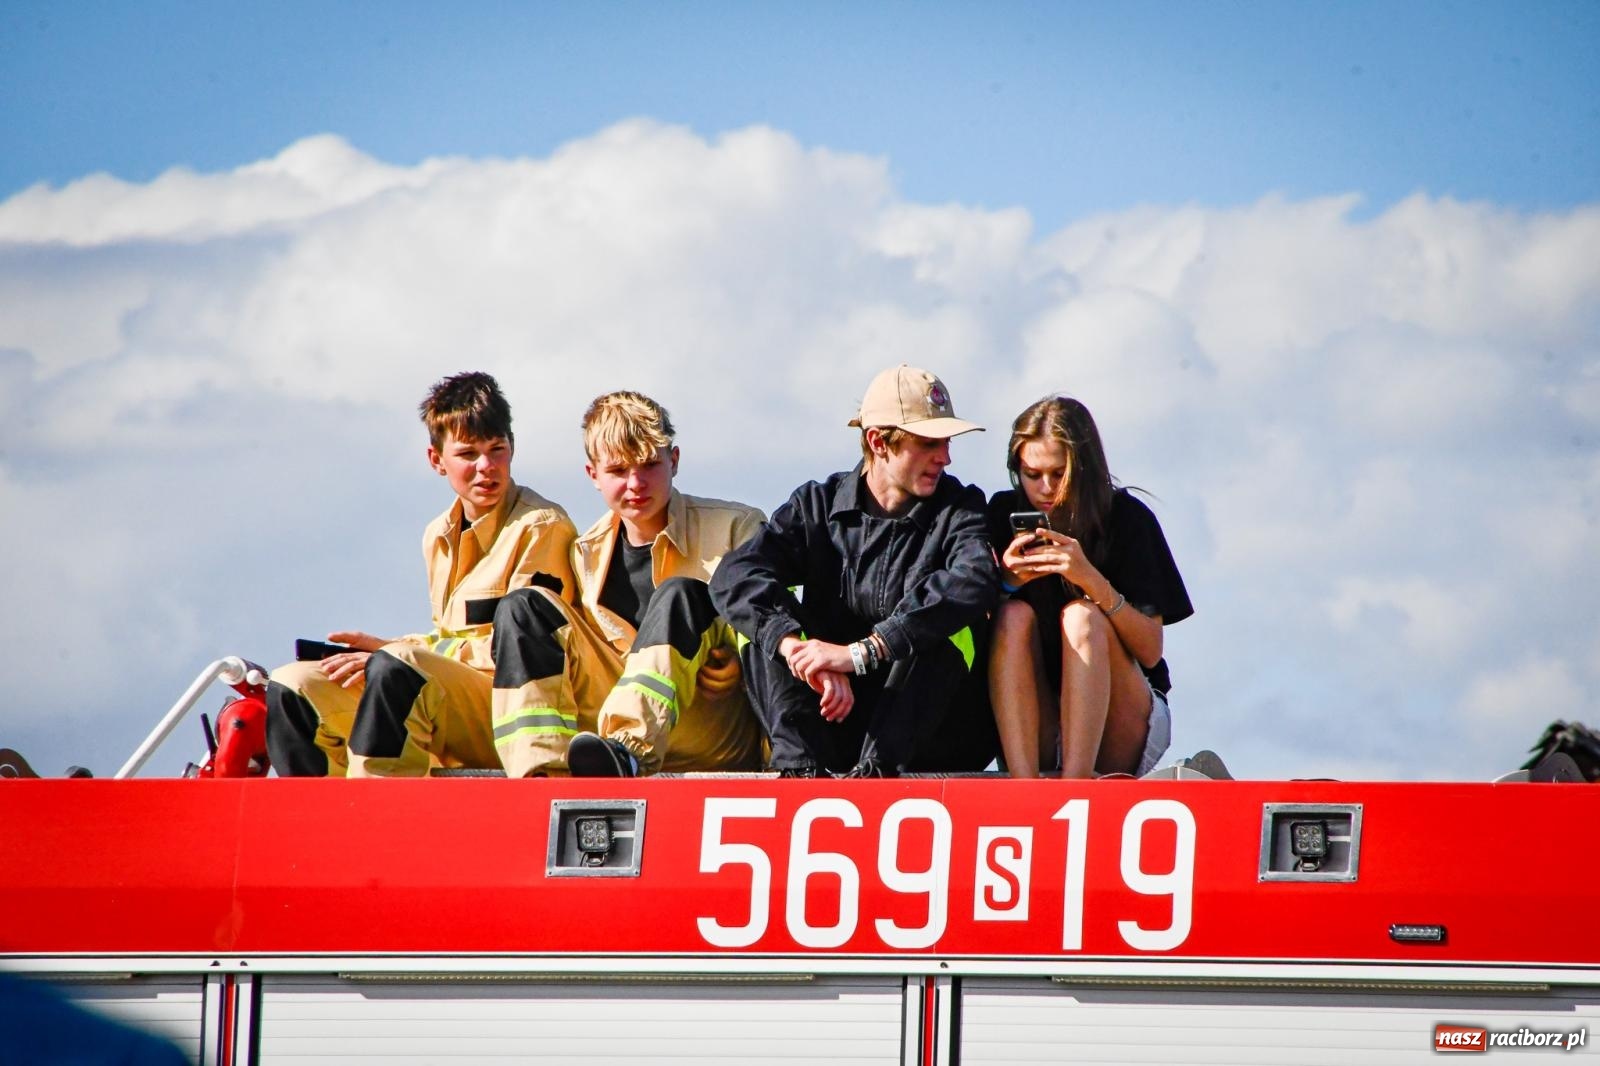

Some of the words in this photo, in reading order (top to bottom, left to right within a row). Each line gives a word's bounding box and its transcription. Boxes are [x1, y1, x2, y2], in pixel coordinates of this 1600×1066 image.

[697, 798, 952, 948] 569
[981, 834, 1025, 914] S
[1052, 799, 1196, 950] 19
